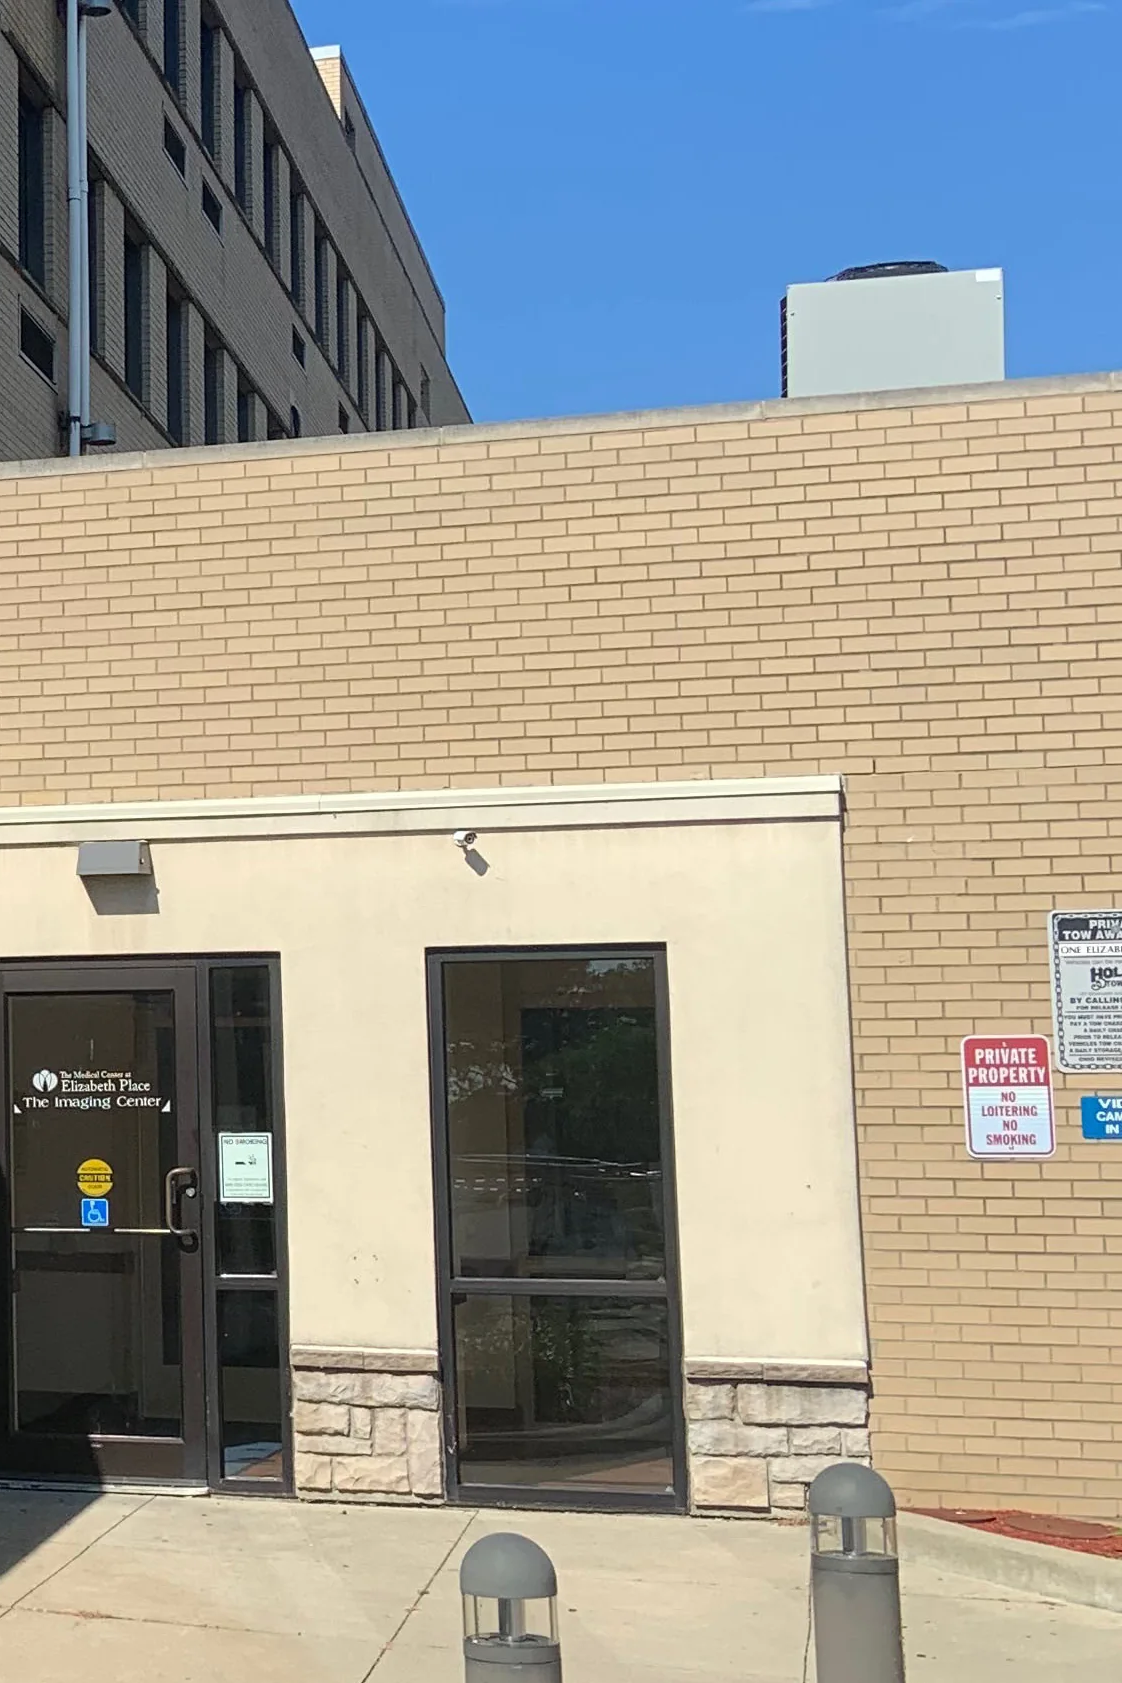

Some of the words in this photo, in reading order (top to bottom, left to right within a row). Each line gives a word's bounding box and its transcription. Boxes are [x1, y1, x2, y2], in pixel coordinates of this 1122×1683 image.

[1089, 919, 1122, 930] PRIV
[1062, 930, 1092, 940] TOW
[1060, 945, 1081, 954] ONE
[1086, 945, 1122, 954] ELIZAB
[974, 1048, 1038, 1065] PRIVATE
[59, 1071, 73, 1079] The
[73, 1070, 100, 1079] Medical
[101, 1070, 124, 1079] Center
[968, 1066, 1046, 1084] PROPERTY
[61, 1079, 117, 1092] Elizabeth
[119, 1078, 151, 1092] Place
[22, 1096, 50, 1108] The
[54, 1095, 112, 1110] Imaging
[116, 1095, 163, 1107] Center
[1000, 1091, 1016, 1103] NO
[981, 1105, 1038, 1117] LOITERING
[1002, 1119, 1018, 1131] NO
[1105, 1124, 1120, 1134] IN
[986, 1133, 1037, 1146] SMOKING
